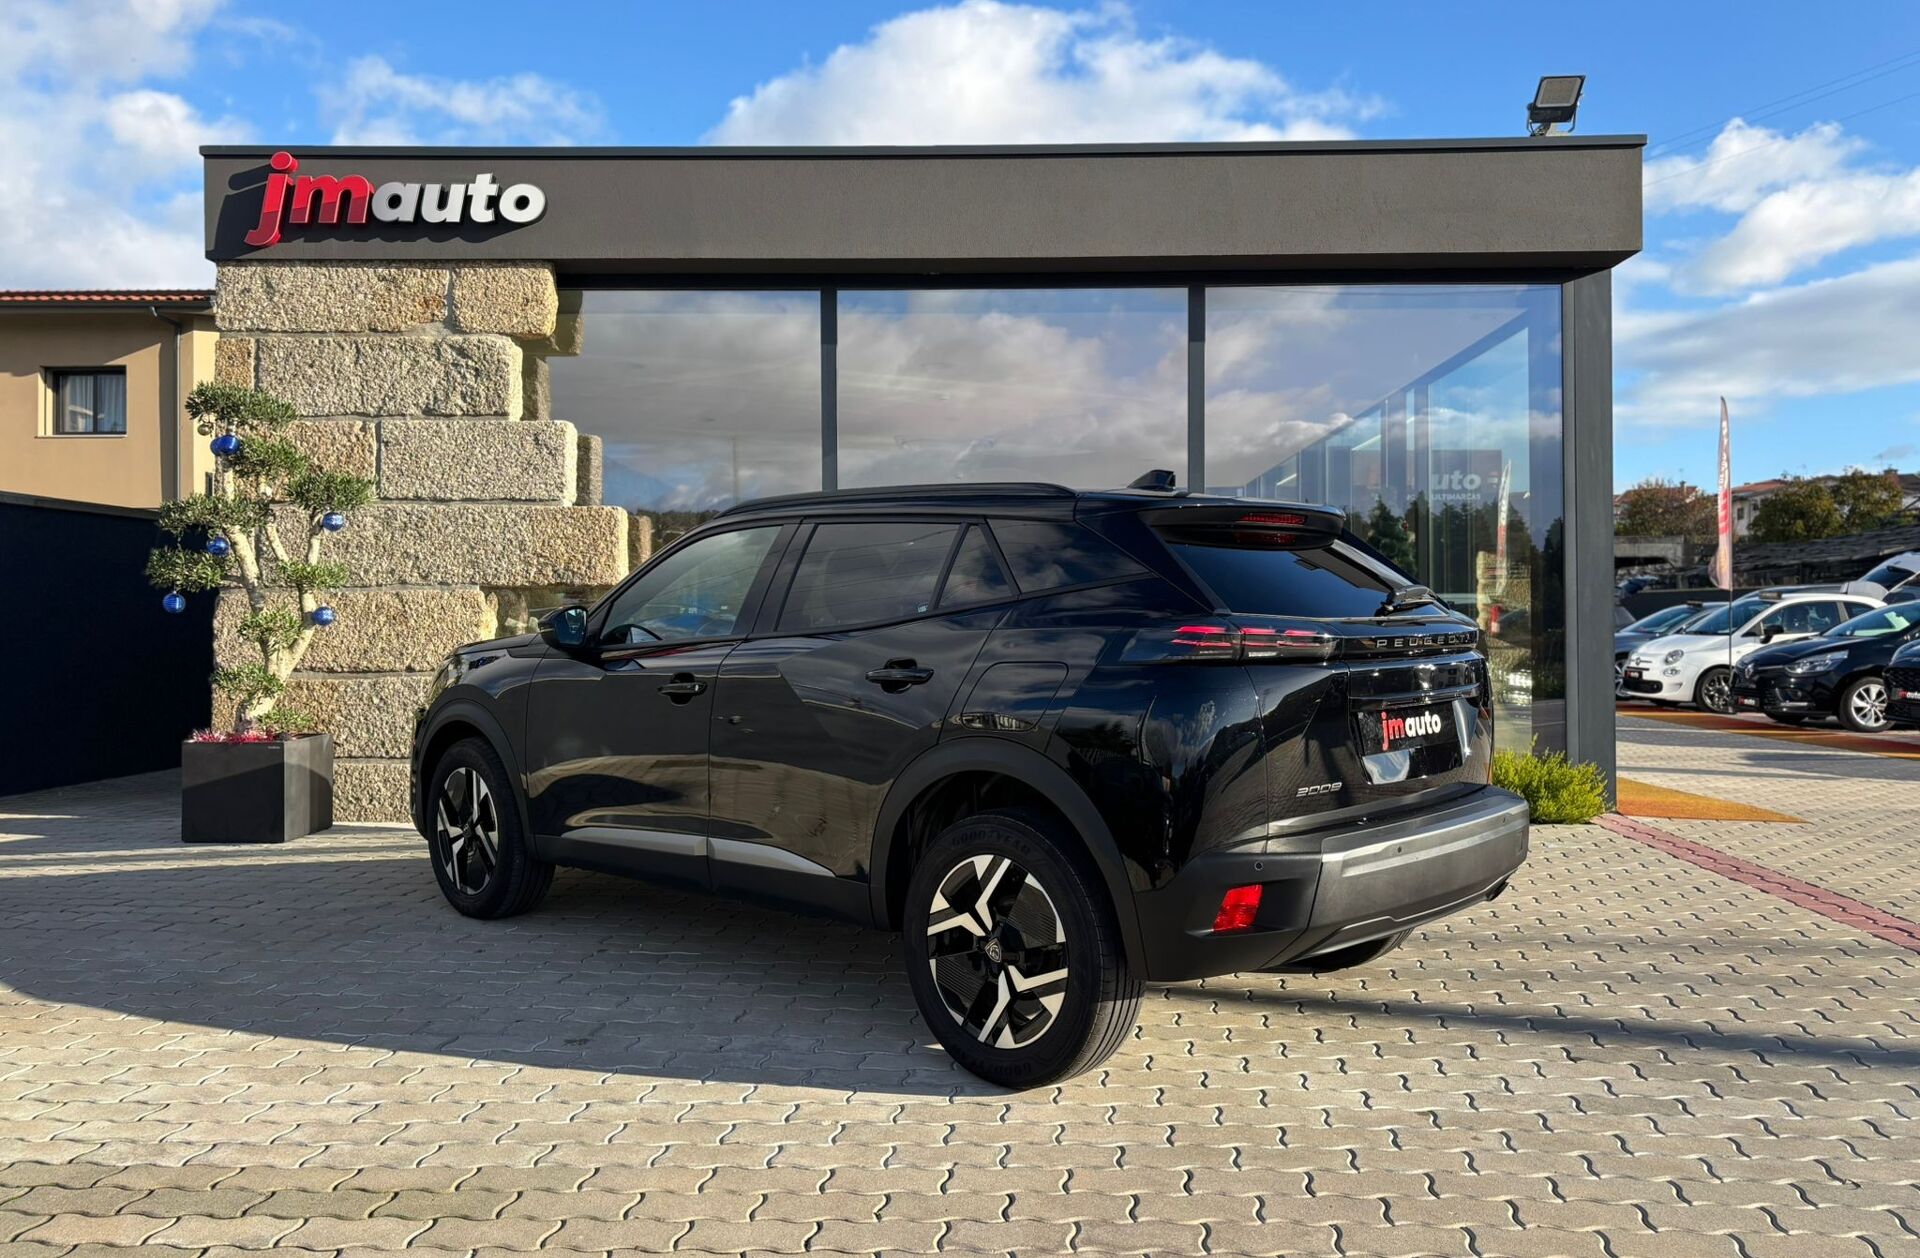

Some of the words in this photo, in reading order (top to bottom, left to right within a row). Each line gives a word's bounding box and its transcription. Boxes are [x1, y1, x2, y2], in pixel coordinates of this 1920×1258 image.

[244, 151, 547, 246] jmauto
[1376, 634, 1467, 648] PEUGEOT
[1380, 710, 1442, 752] jmauto
